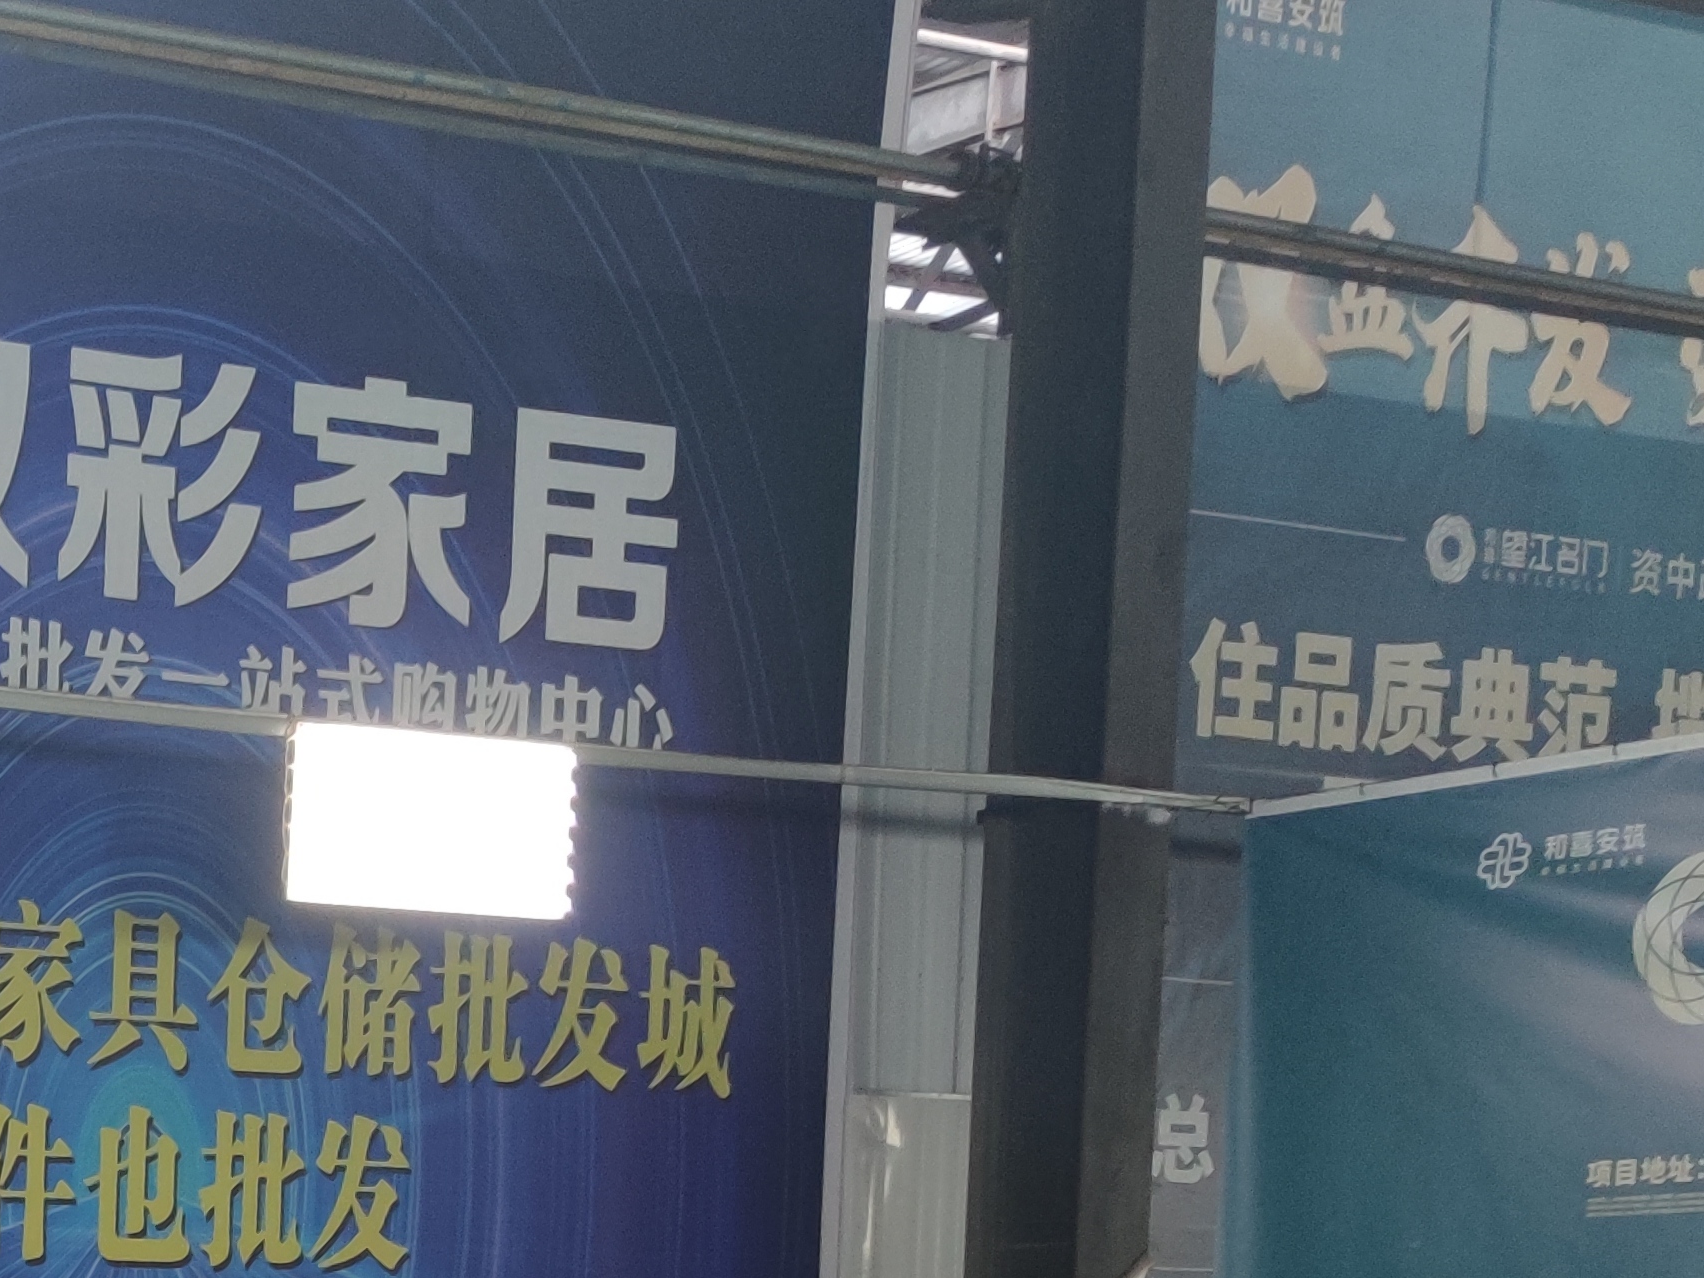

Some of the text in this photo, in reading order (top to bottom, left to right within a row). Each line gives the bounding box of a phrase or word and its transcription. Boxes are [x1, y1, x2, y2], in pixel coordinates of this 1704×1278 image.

[1630, 548, 1704, 601] 资中
[1190, 617, 1617, 763] 住品质典范
